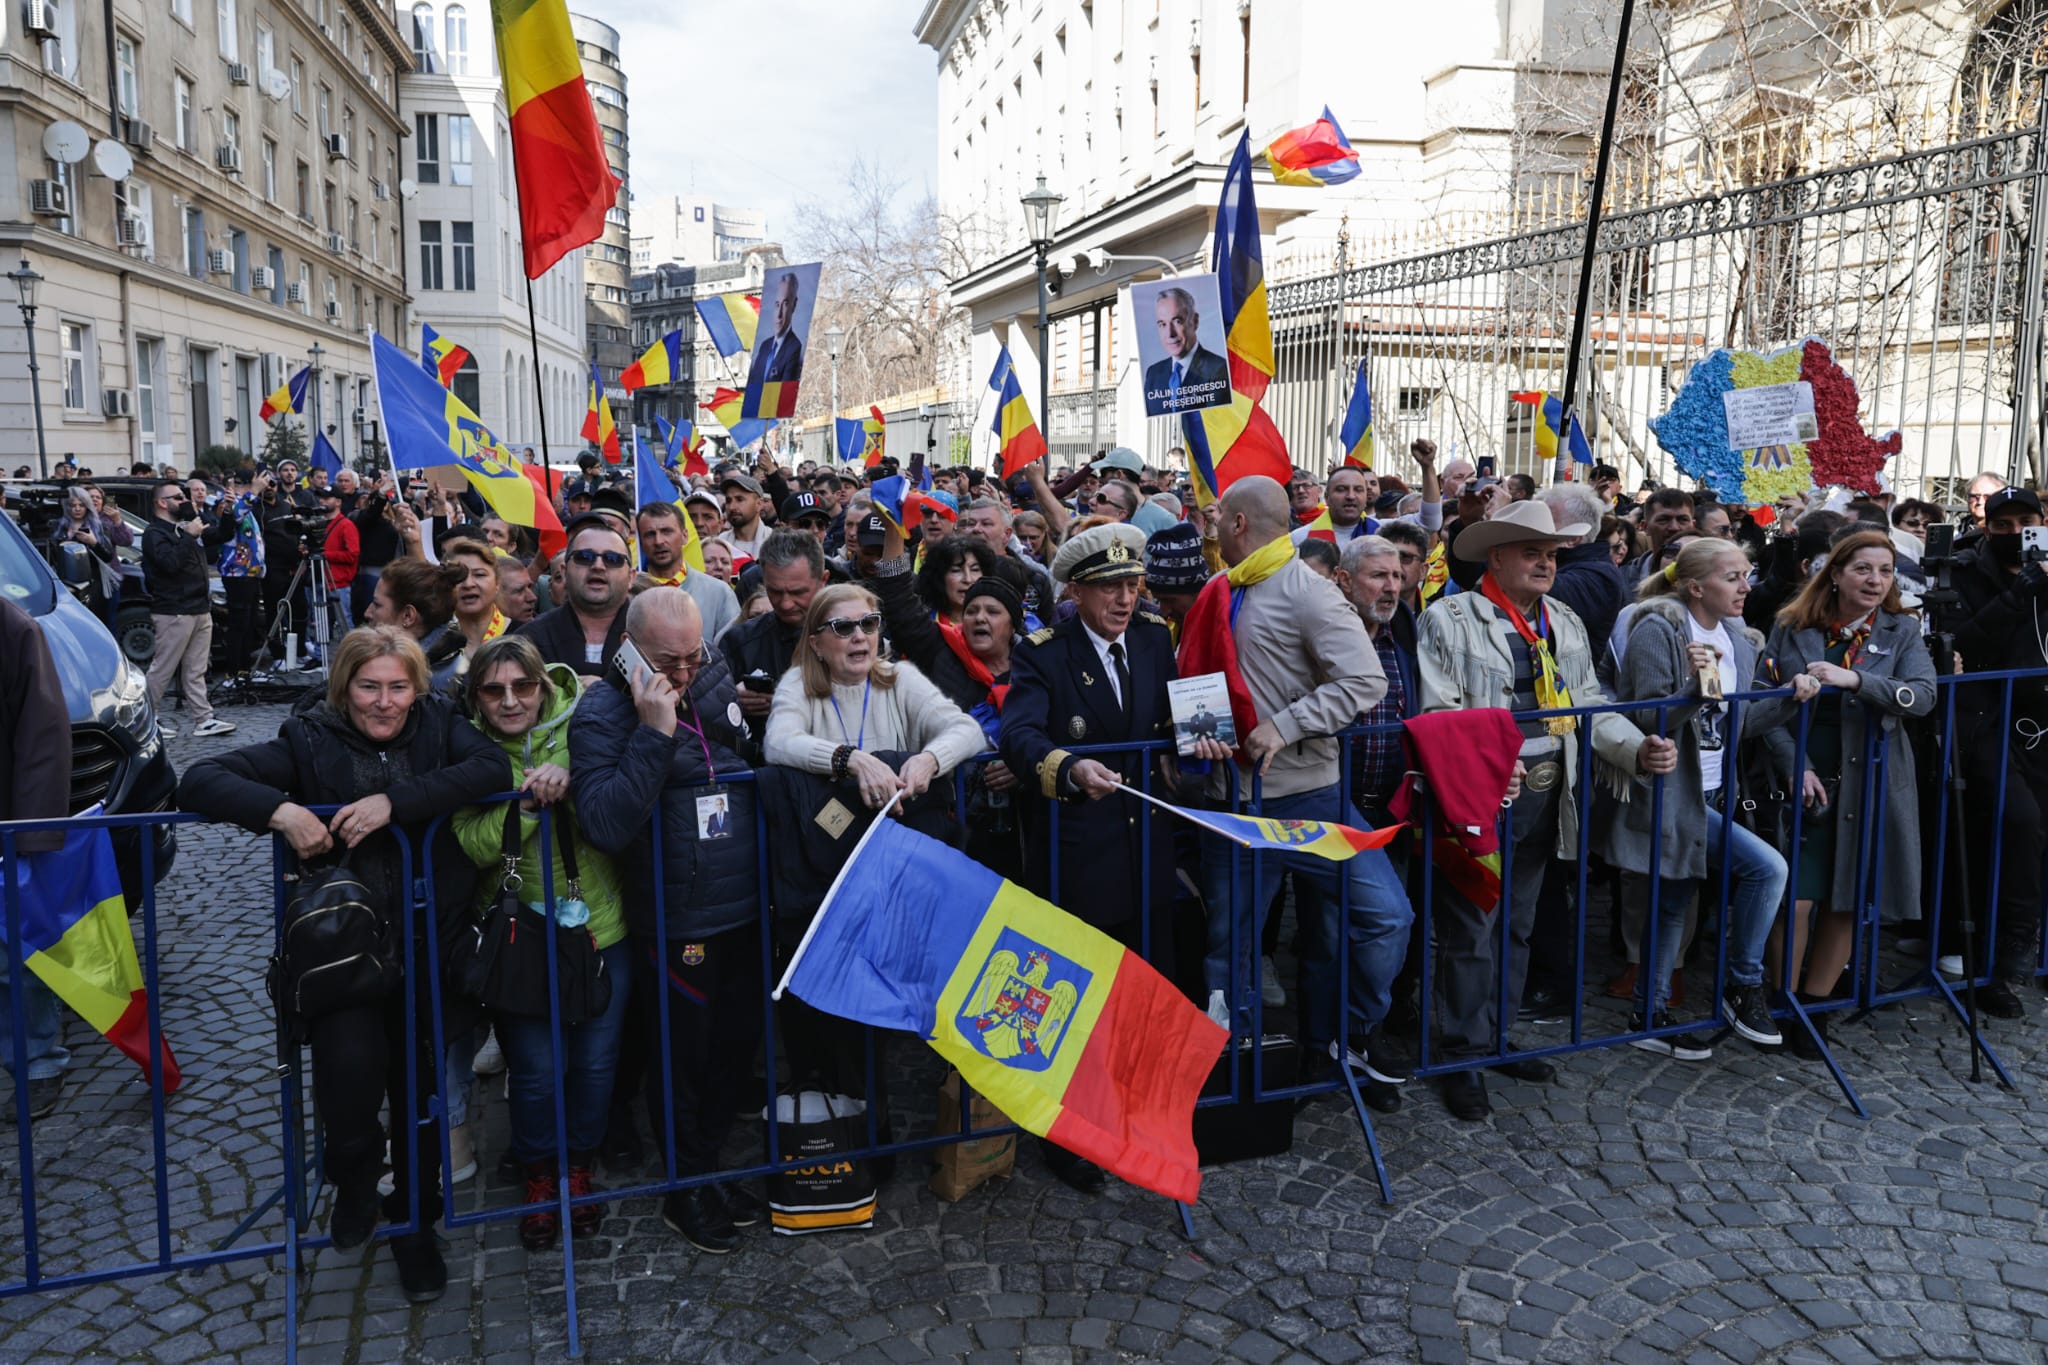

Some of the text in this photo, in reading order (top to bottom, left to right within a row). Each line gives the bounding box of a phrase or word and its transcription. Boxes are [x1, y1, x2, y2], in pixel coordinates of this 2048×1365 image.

[1147, 380, 1226, 400] CĂLIN GEORGESCU
[797, 493, 814, 507] 10
